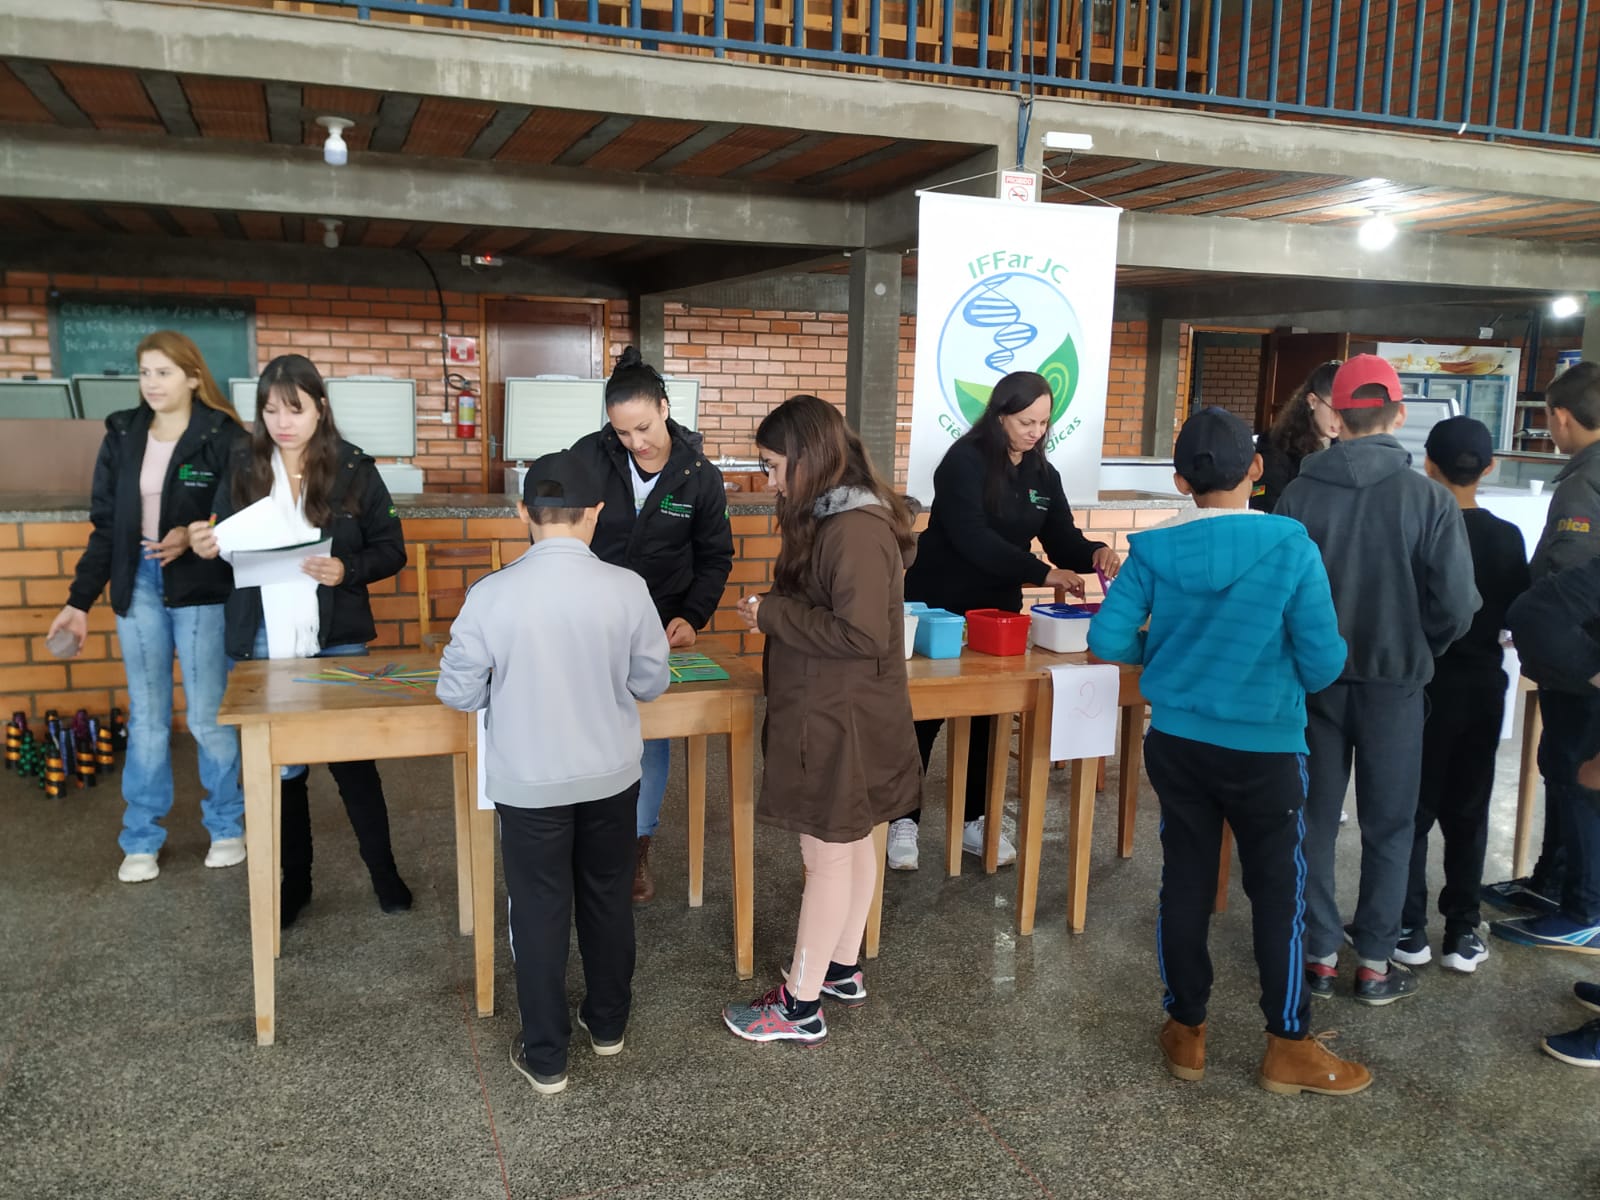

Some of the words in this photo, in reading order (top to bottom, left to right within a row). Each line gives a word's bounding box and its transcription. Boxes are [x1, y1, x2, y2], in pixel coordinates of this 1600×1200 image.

[967, 250, 1034, 279] IFFar
[1036, 258, 1069, 284] JC
[1072, 680, 1103, 719] 2
